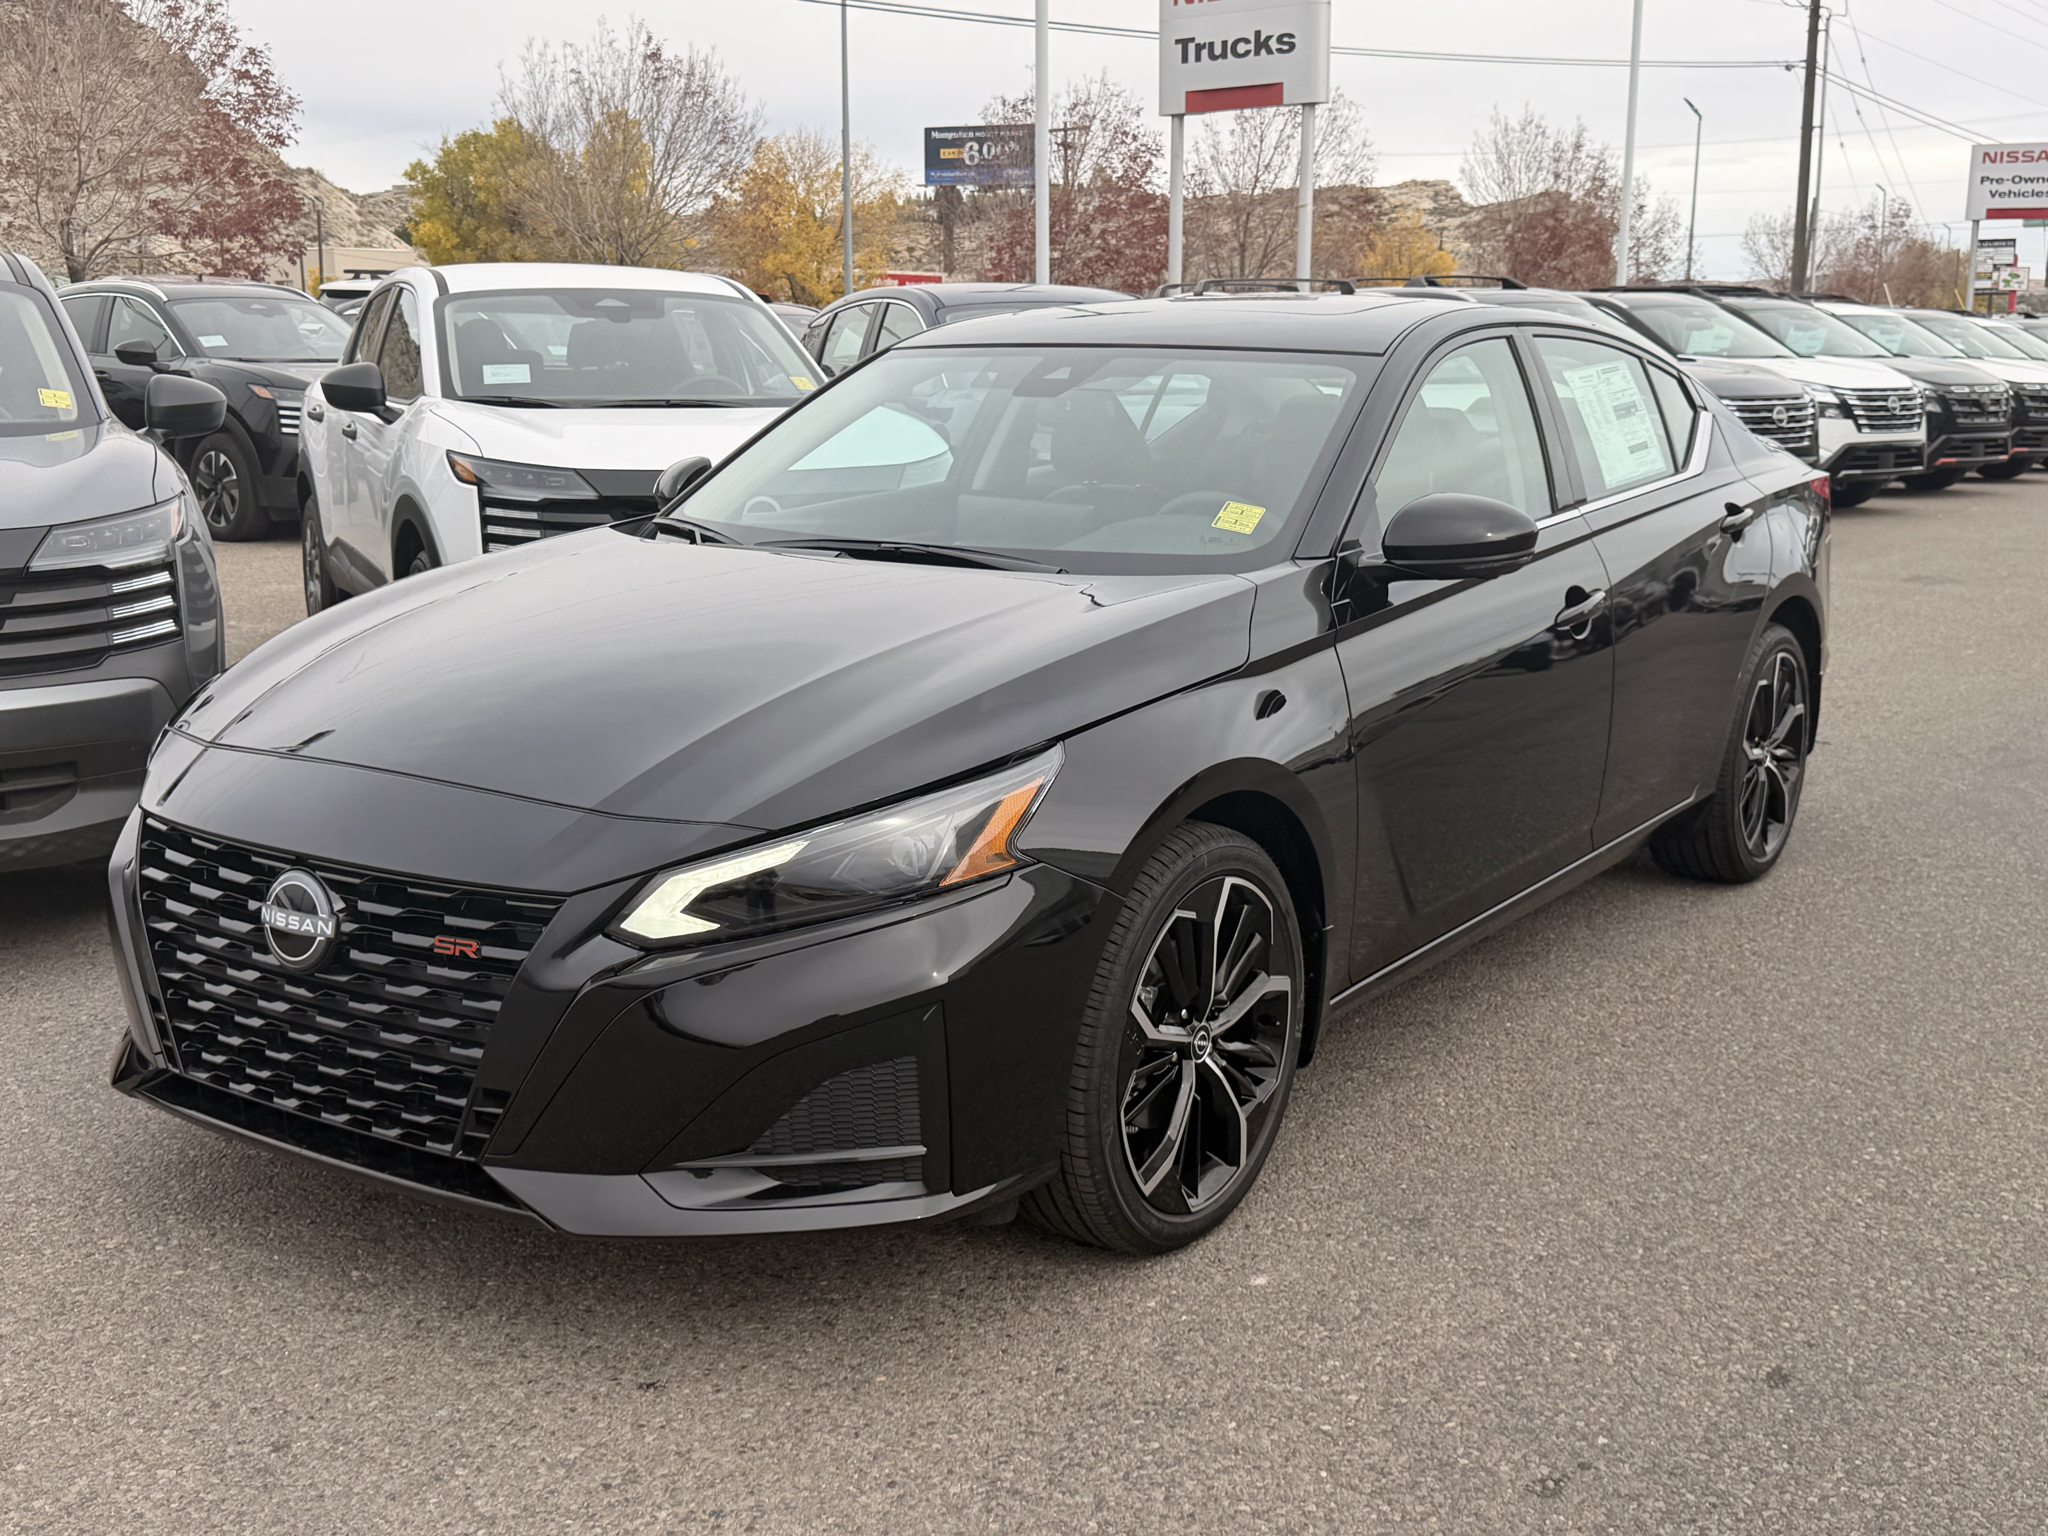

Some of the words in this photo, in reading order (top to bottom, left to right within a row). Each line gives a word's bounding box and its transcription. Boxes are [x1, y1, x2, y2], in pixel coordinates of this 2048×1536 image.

[1174, 30, 1297, 64] Trucks
[1980, 174, 2048, 186] Pre-Own
[261, 906, 333, 936] NISSAN
[433, 935, 480, 959] SR
